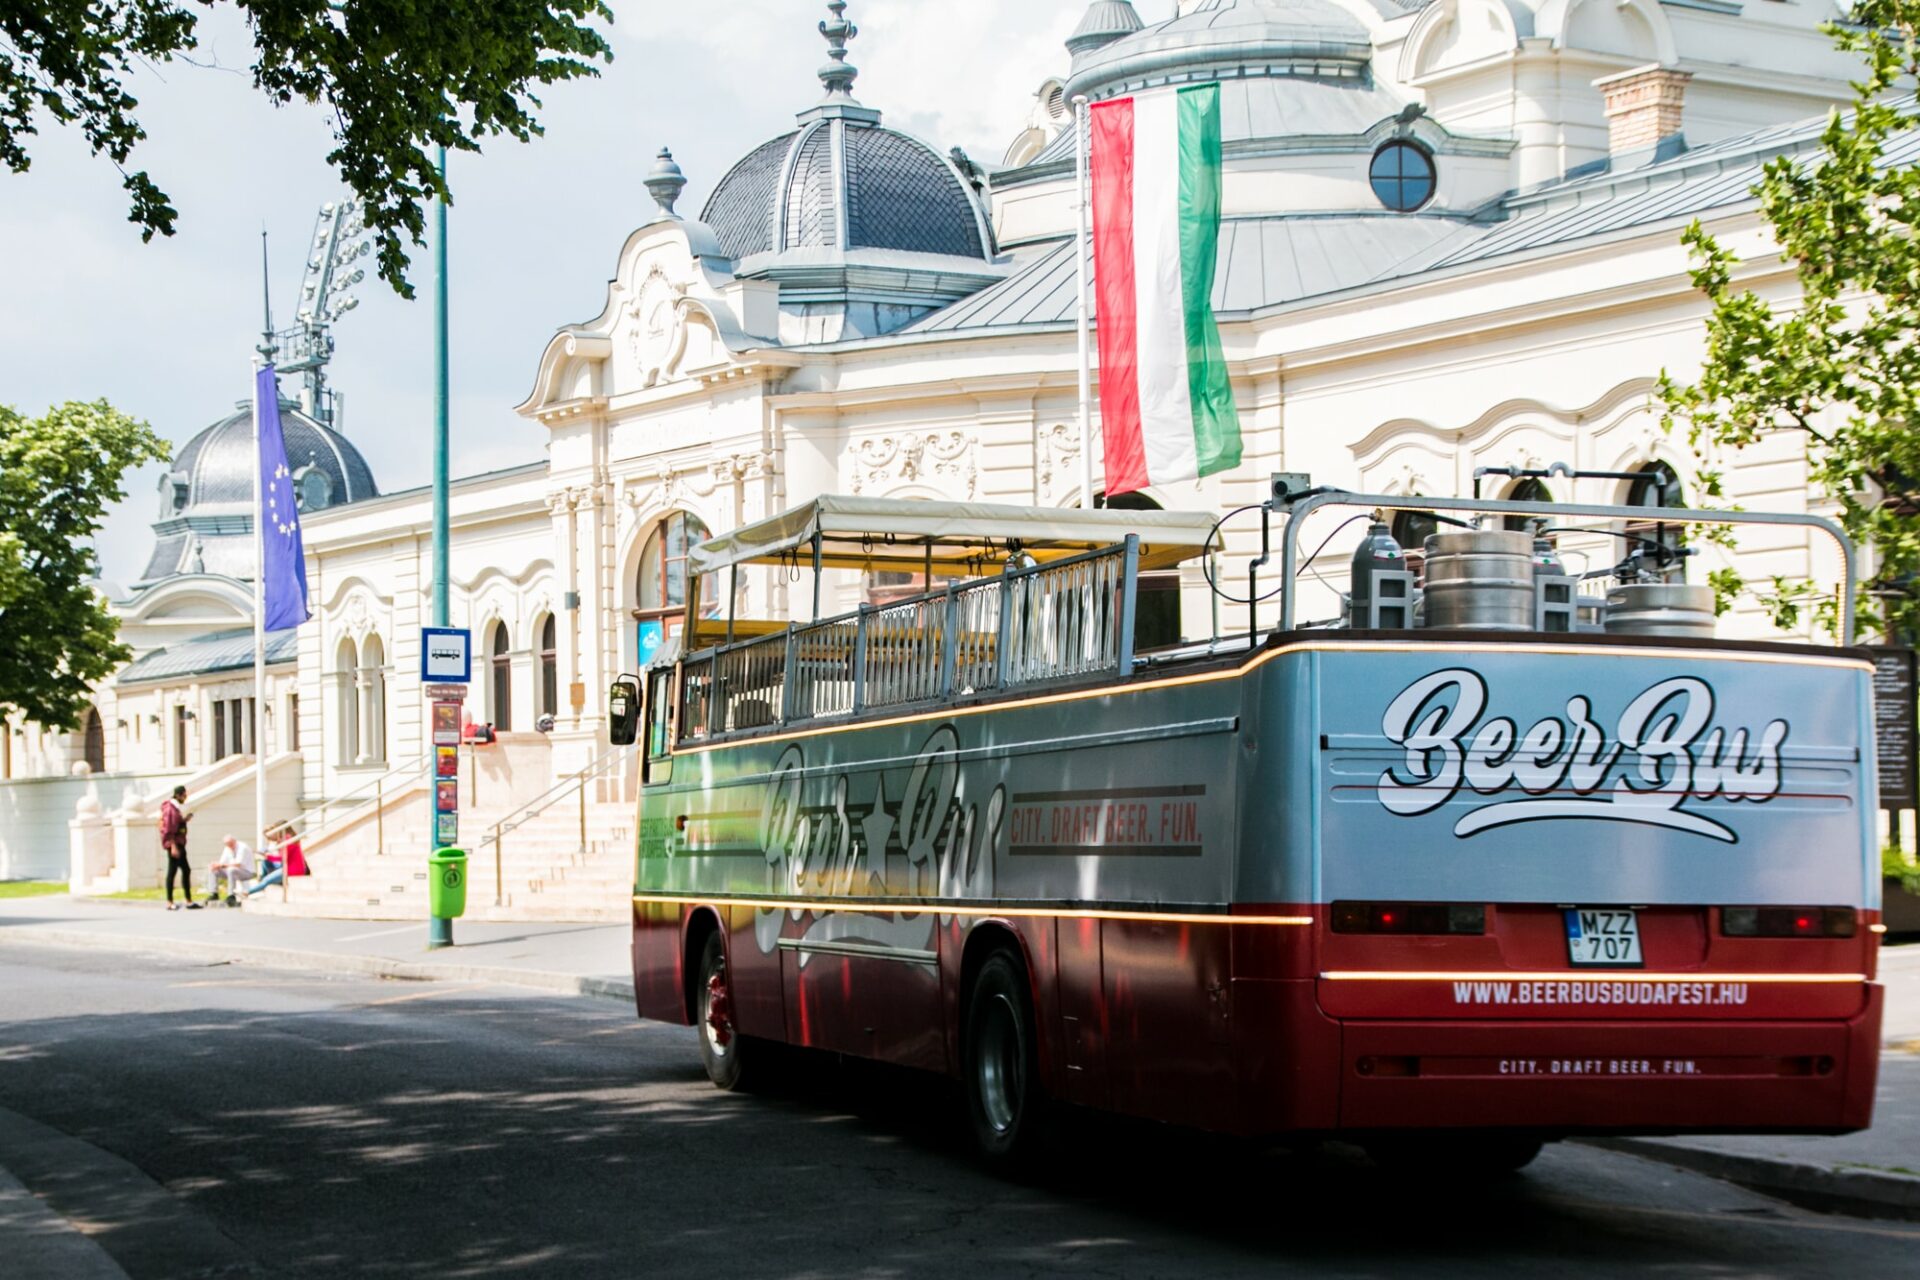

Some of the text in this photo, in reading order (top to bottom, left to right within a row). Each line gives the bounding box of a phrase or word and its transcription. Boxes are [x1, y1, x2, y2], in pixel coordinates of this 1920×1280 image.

[1010, 801, 1203, 844] CITY. DRAFT BEER. FUN.
[1581, 912, 1634, 935] MZZ
[1588, 937, 1632, 959] 707
[1453, 982, 1748, 1004] WWW.BEERBUSBUDAPEST.HU
[1499, 1060, 1702, 1074] CITY. DRAFT BEER. FUN.
